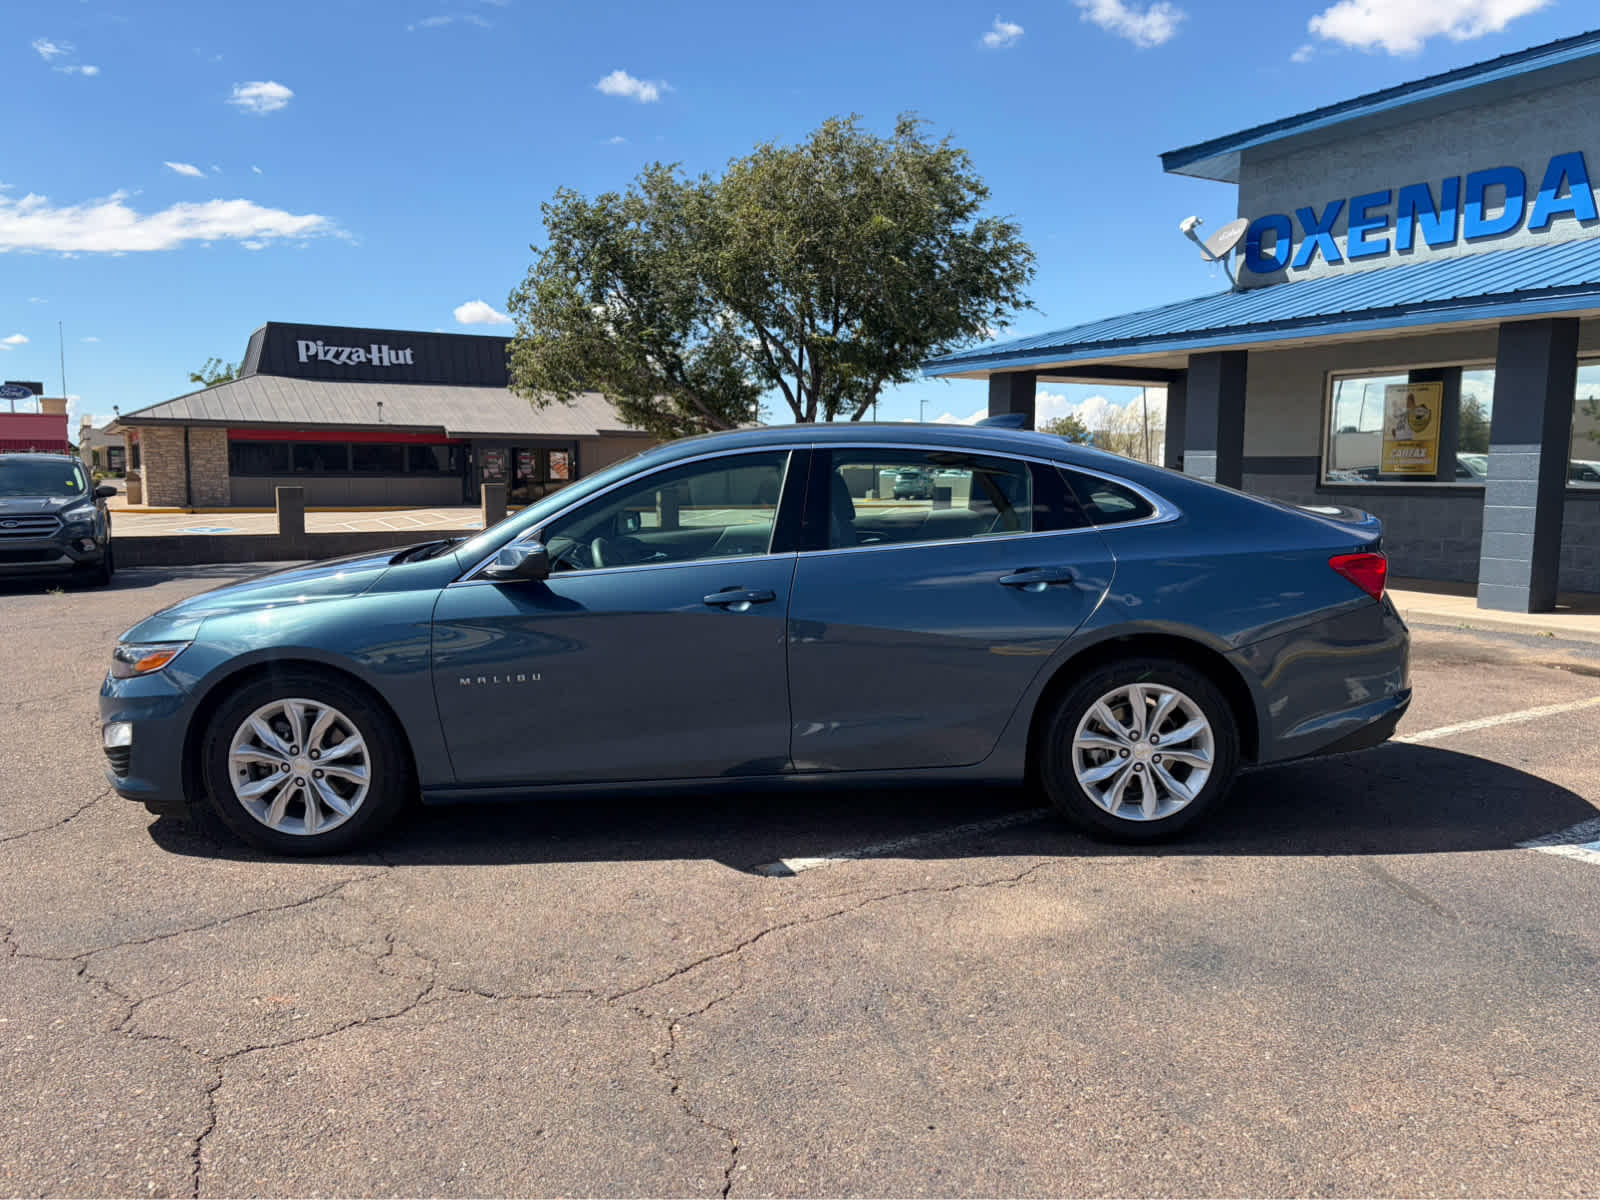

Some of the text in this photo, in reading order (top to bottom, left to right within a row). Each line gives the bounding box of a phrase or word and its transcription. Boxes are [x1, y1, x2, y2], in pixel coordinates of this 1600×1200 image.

[1245, 151, 1599, 274] OXENDA
[296, 340, 414, 366] Pizza Hut
[459, 673, 541, 686] MALIBU
